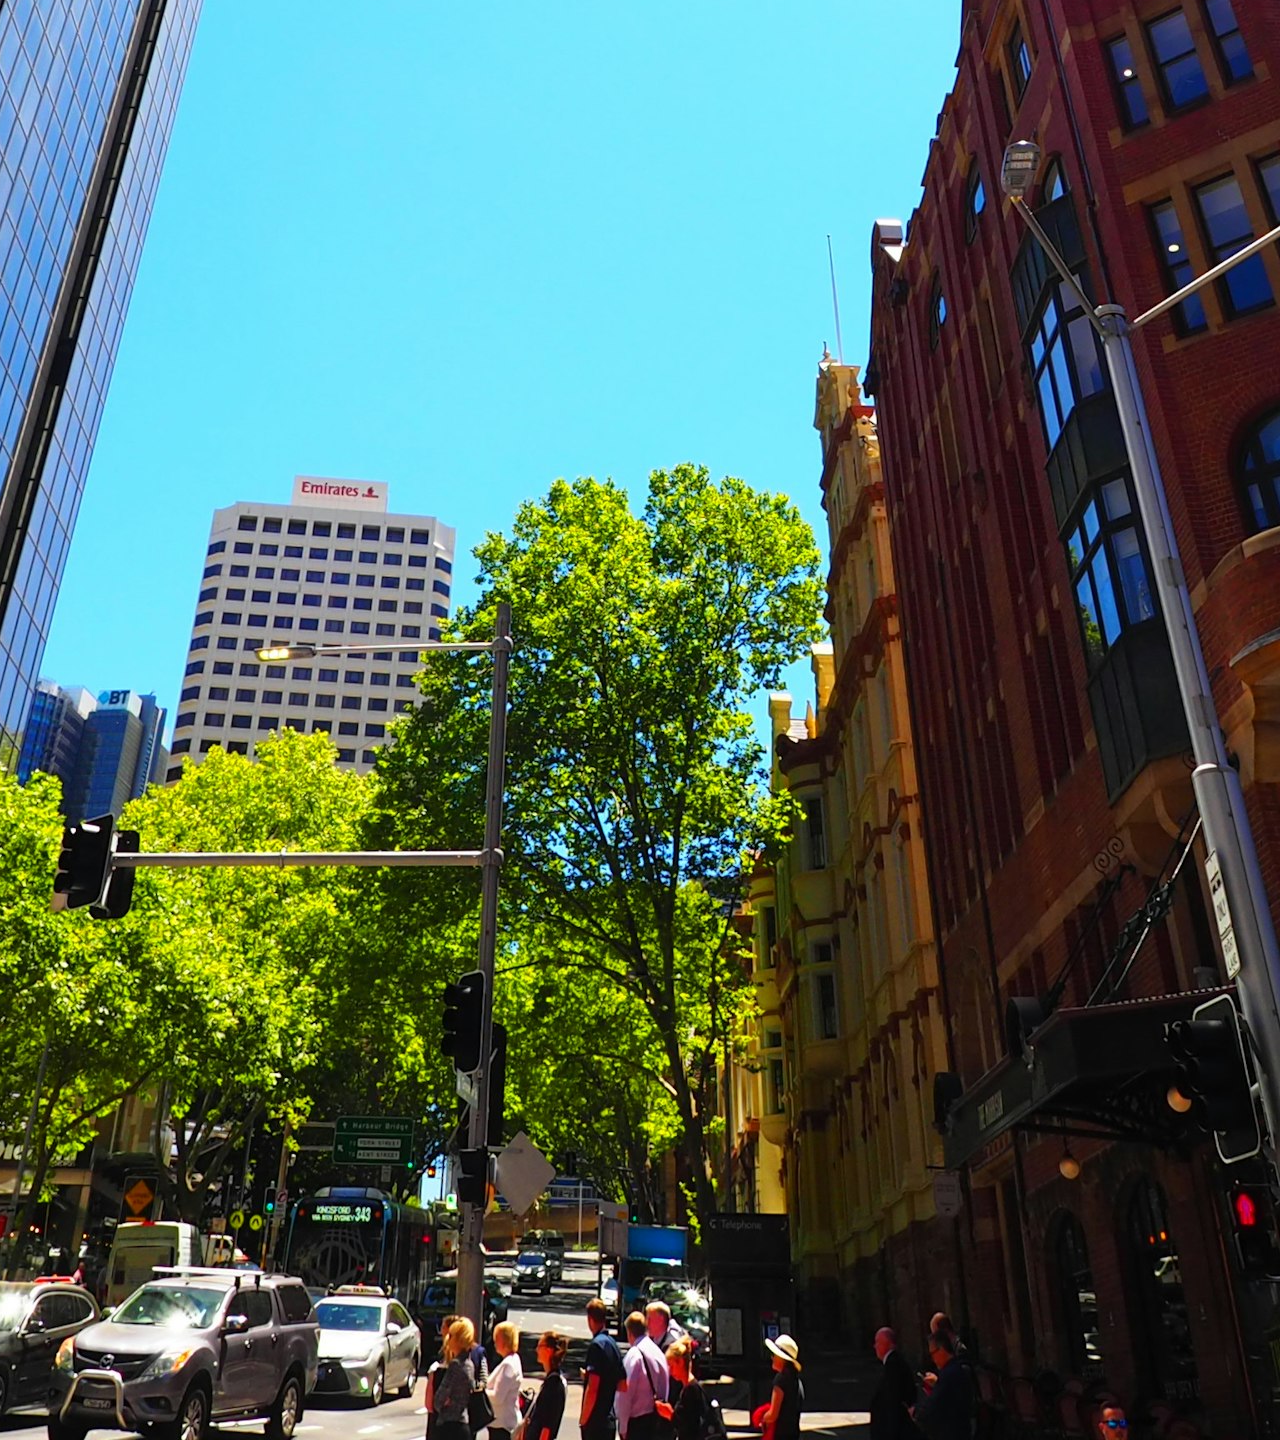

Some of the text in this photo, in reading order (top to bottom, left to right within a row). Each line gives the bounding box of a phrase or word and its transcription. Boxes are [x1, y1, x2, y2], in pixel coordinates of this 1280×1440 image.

[301, 481, 359, 497] Emirates
[109, 690, 131, 705] BT
[352, 1122, 408, 1131] Harbour Bridge
[316, 1206, 351, 1214] KINGSFORD
[355, 1206, 371, 1222] 343
[721, 1219, 762, 1230] Telephone
